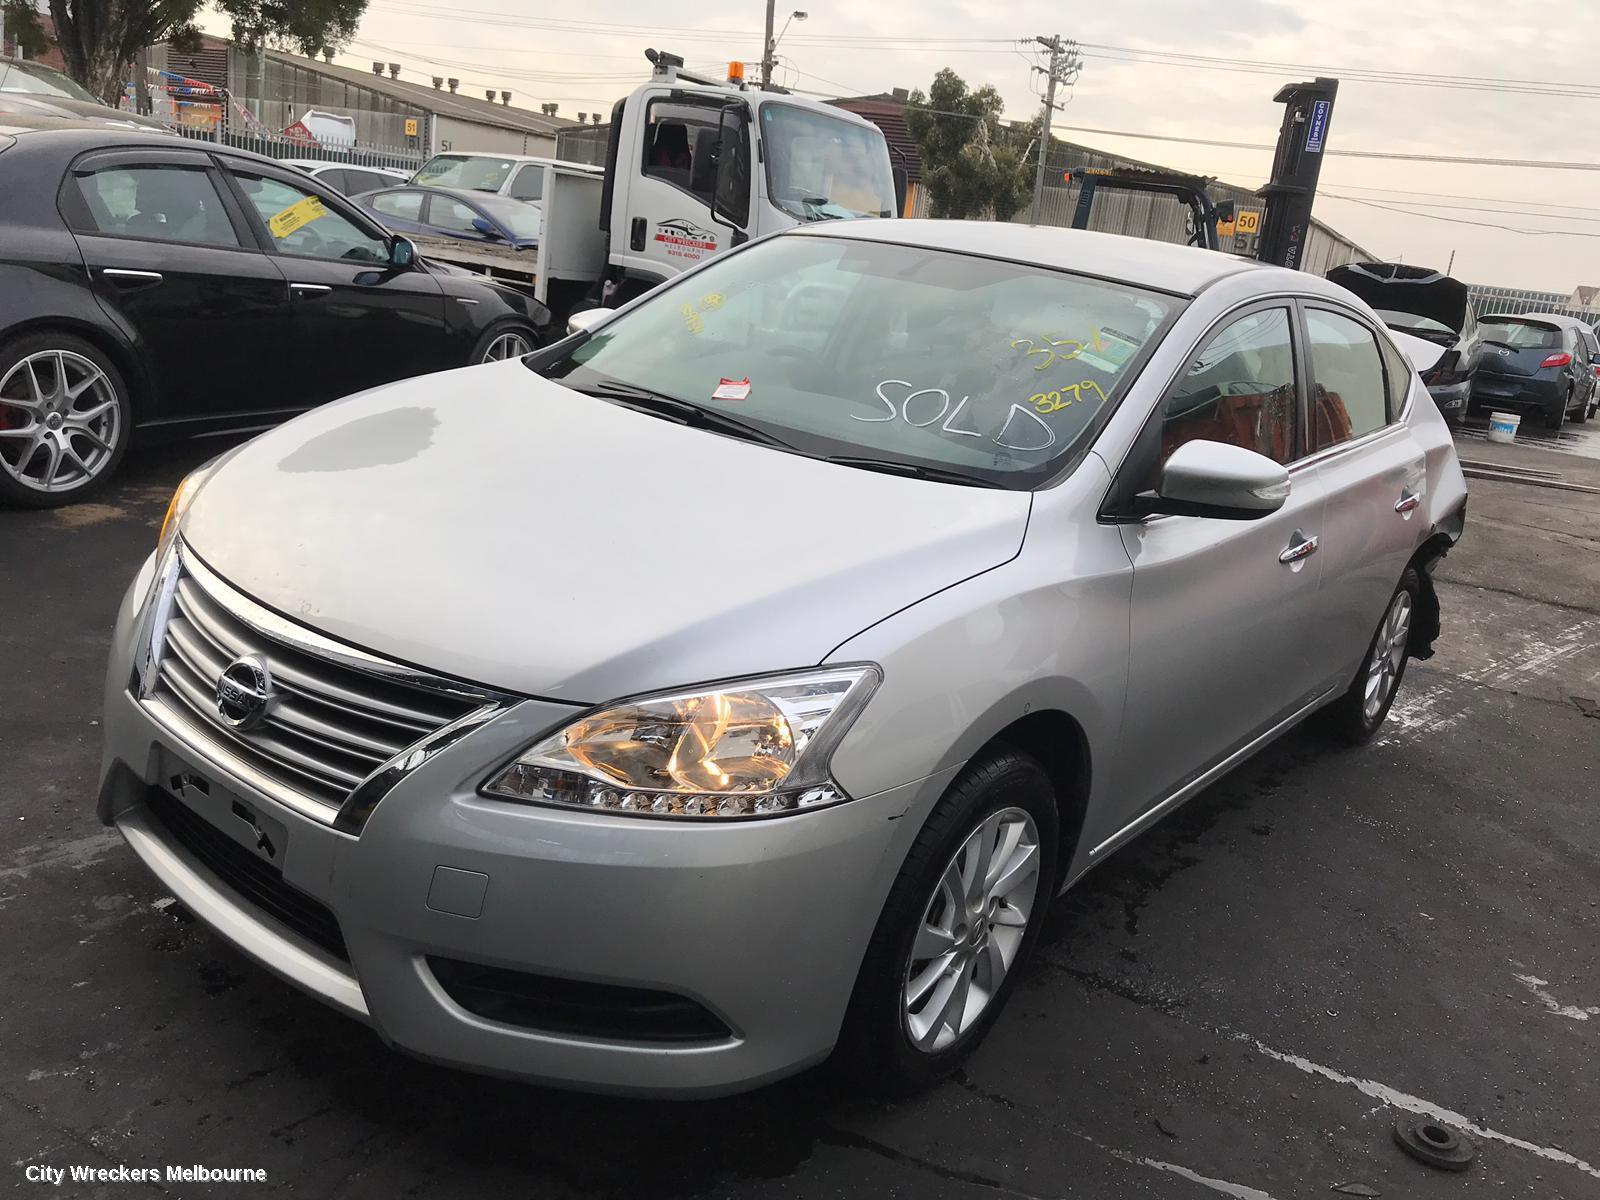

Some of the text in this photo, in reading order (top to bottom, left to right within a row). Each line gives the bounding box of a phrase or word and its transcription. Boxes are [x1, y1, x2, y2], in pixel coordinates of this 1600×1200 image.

[1313, 103, 1325, 138] COYNES
[1239, 215, 1256, 229] 50
[663, 235, 706, 248] CITY WRECKERS
[1028, 380, 1107, 414] 3279
[849, 379, 1056, 451] SOLD
